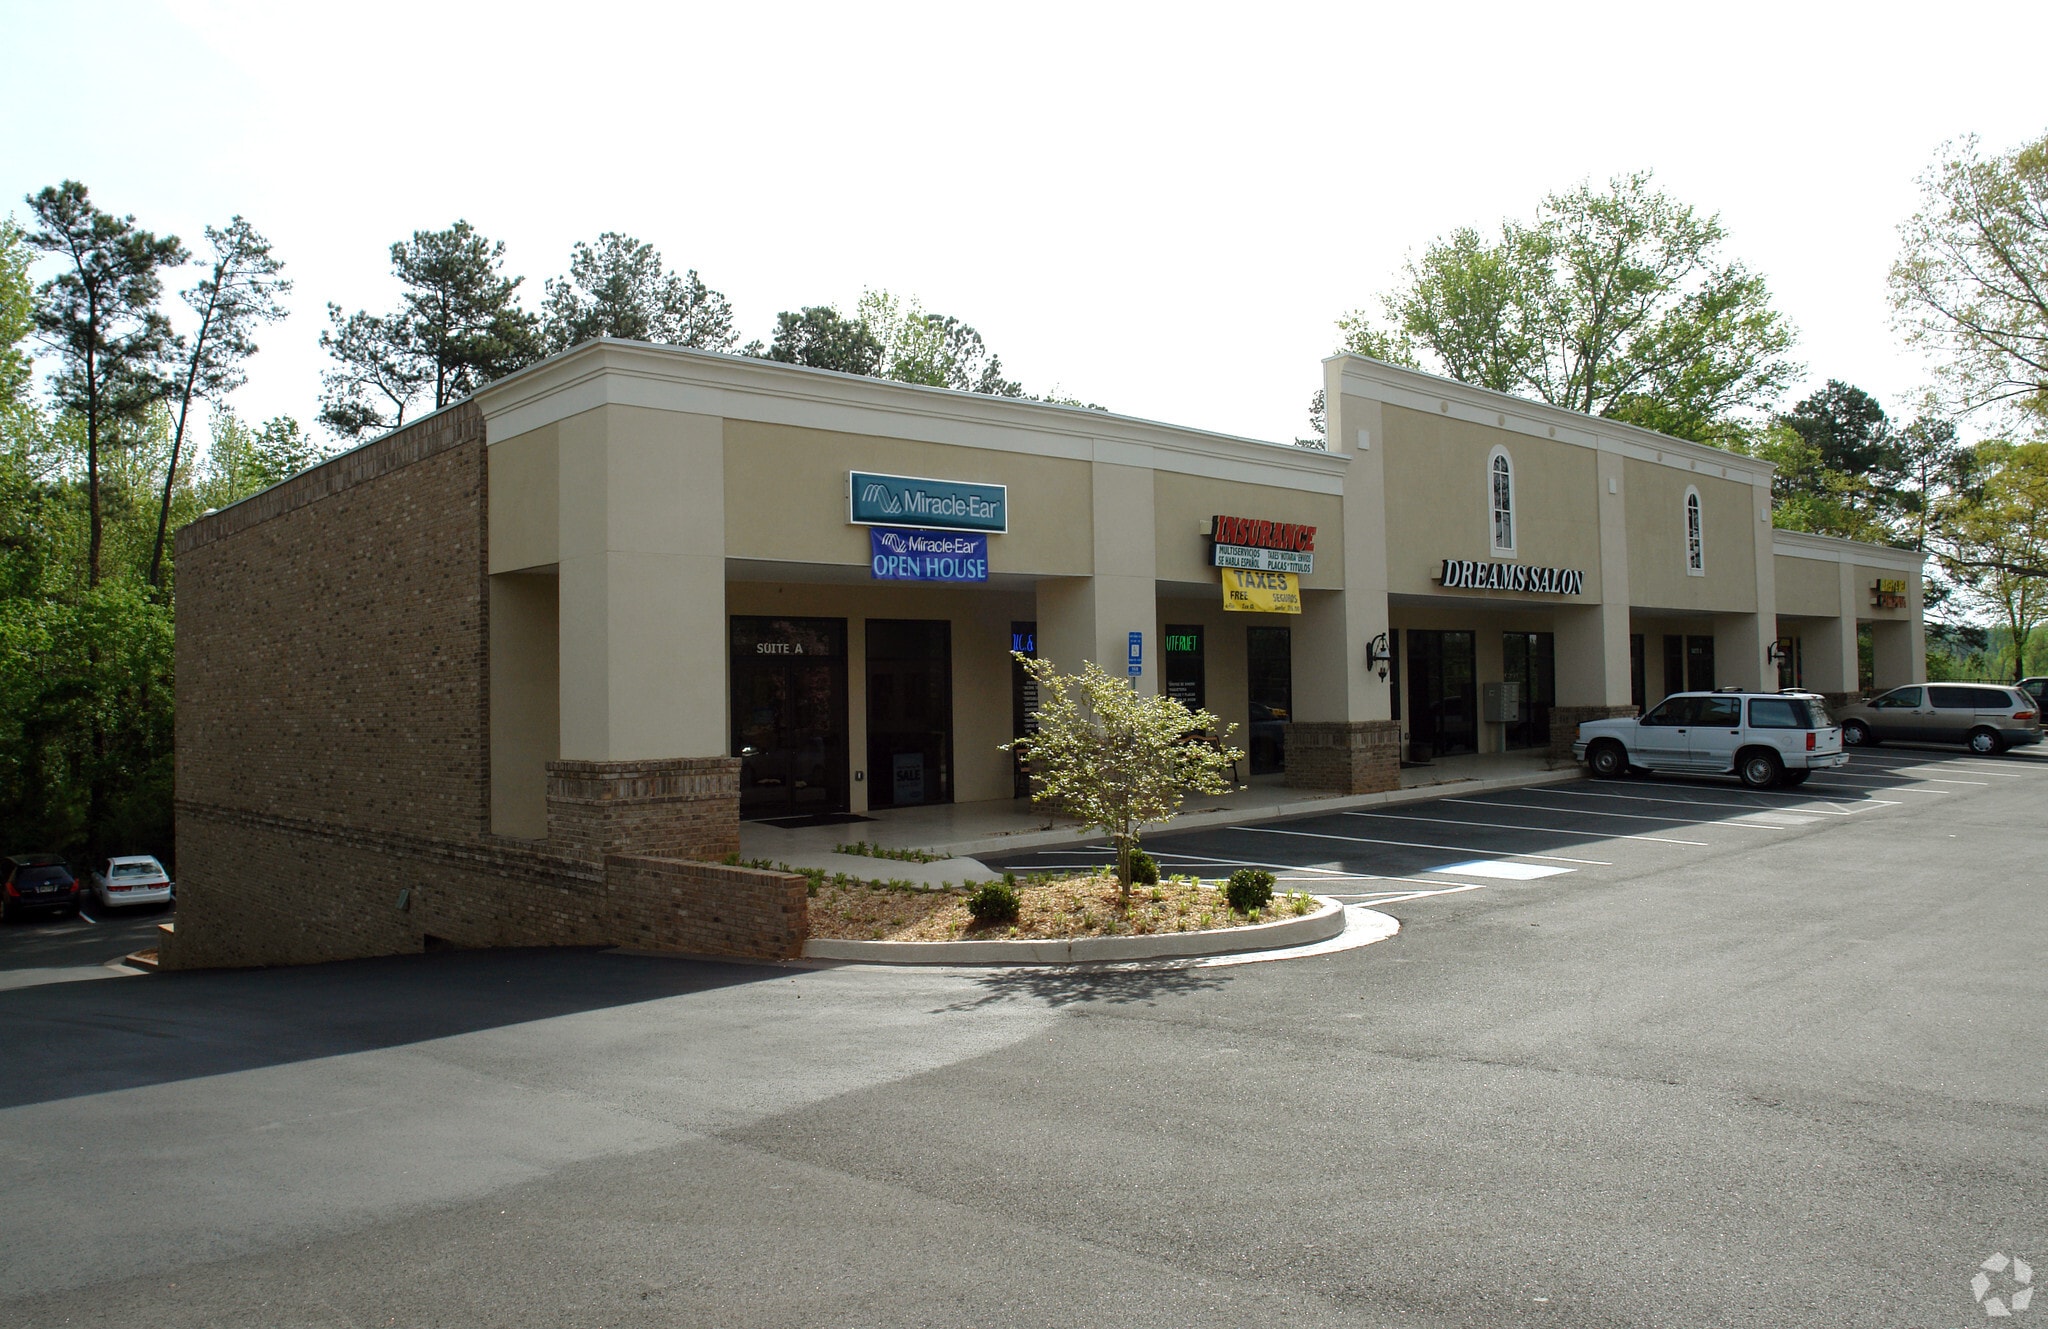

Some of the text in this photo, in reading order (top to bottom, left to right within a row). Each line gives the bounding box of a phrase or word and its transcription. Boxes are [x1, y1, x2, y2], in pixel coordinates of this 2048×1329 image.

[1215, 515, 1317, 551] INSURANCE
[1219, 546, 1260, 558] MULTISERVICIOS
[873, 554, 986, 578] OPEN HOUSE
[1225, 557, 1240, 567] HABLA
[1267, 560, 1311, 573] PLACAS TITULOS
[1233, 569, 1288, 591] TAXES
[1443, 559, 1585, 595] DREAMS SALON
[1230, 590, 1249, 601] FREE
[756, 643, 804, 654] SUITE A
[896, 769, 921, 782] SALE
